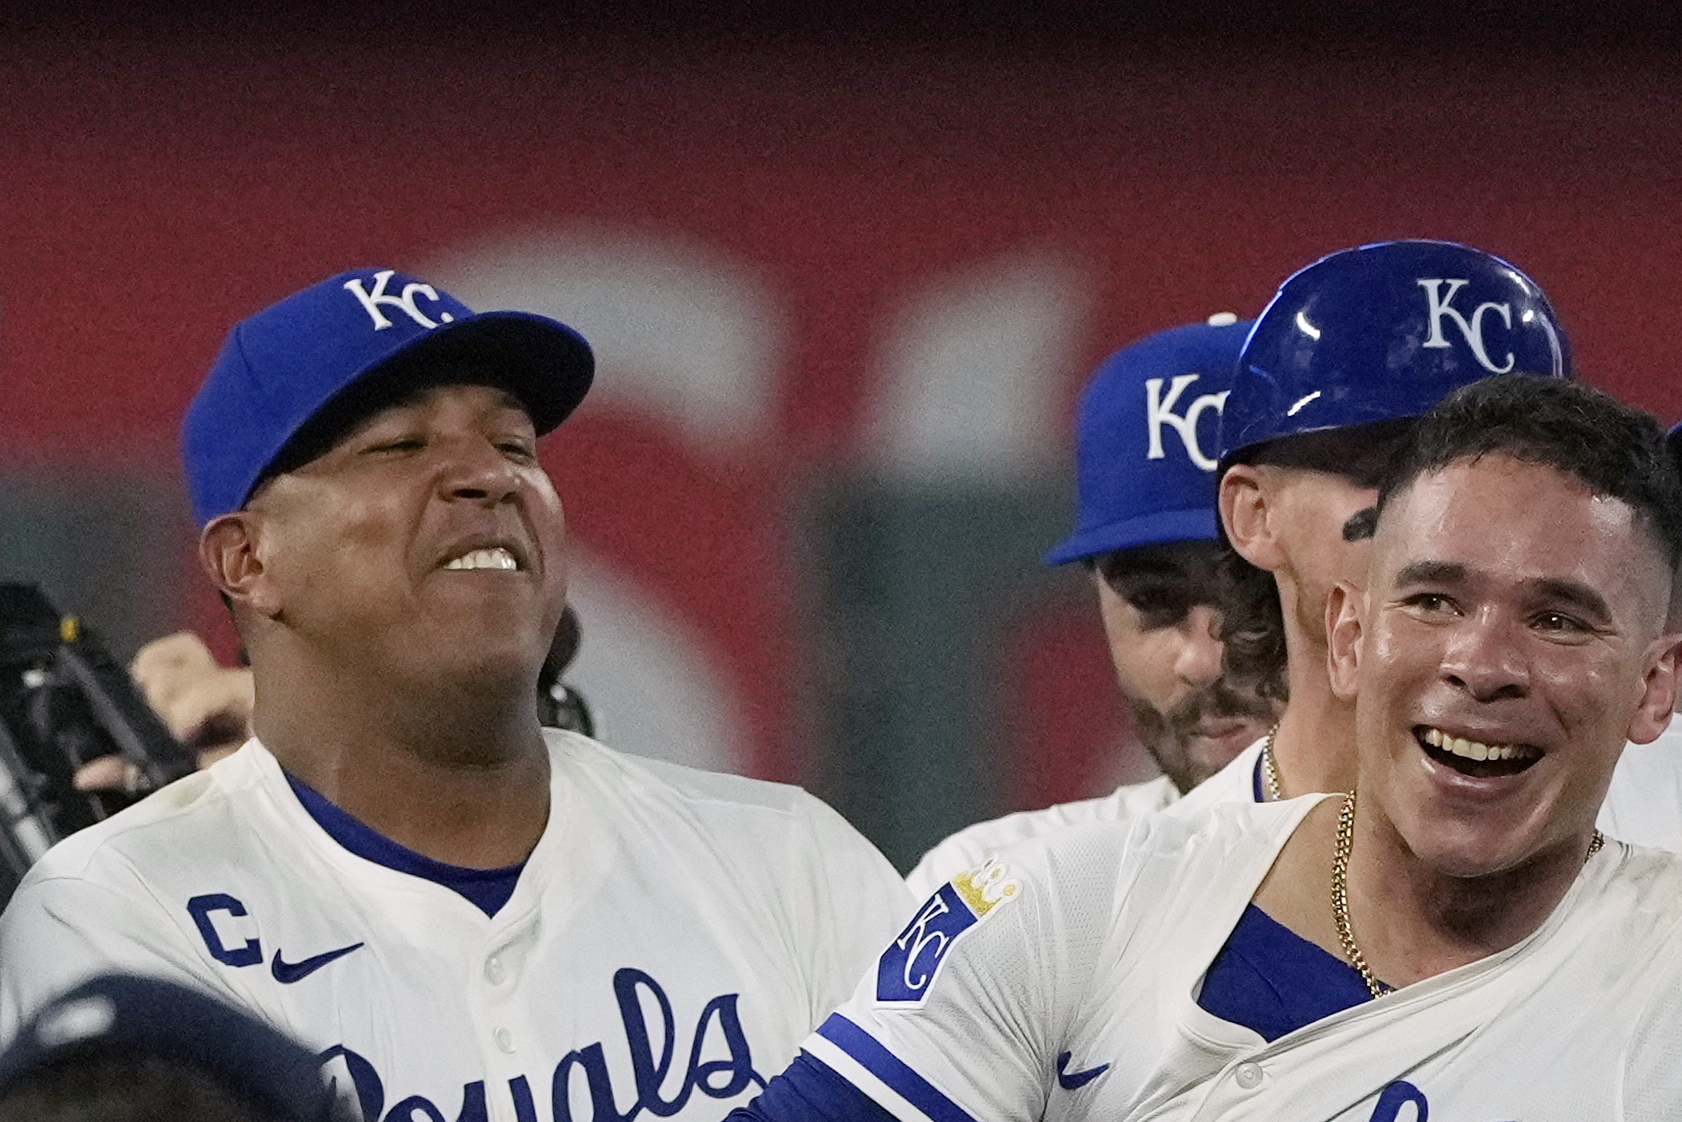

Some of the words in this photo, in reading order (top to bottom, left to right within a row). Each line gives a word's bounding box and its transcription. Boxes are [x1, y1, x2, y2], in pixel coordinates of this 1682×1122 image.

[343, 269, 454, 331] KC
[1417, 278, 1515, 374] KC
[1146, 374, 1232, 472] KC
[186, 893, 263, 967] C
[897, 893, 950, 990] KC
